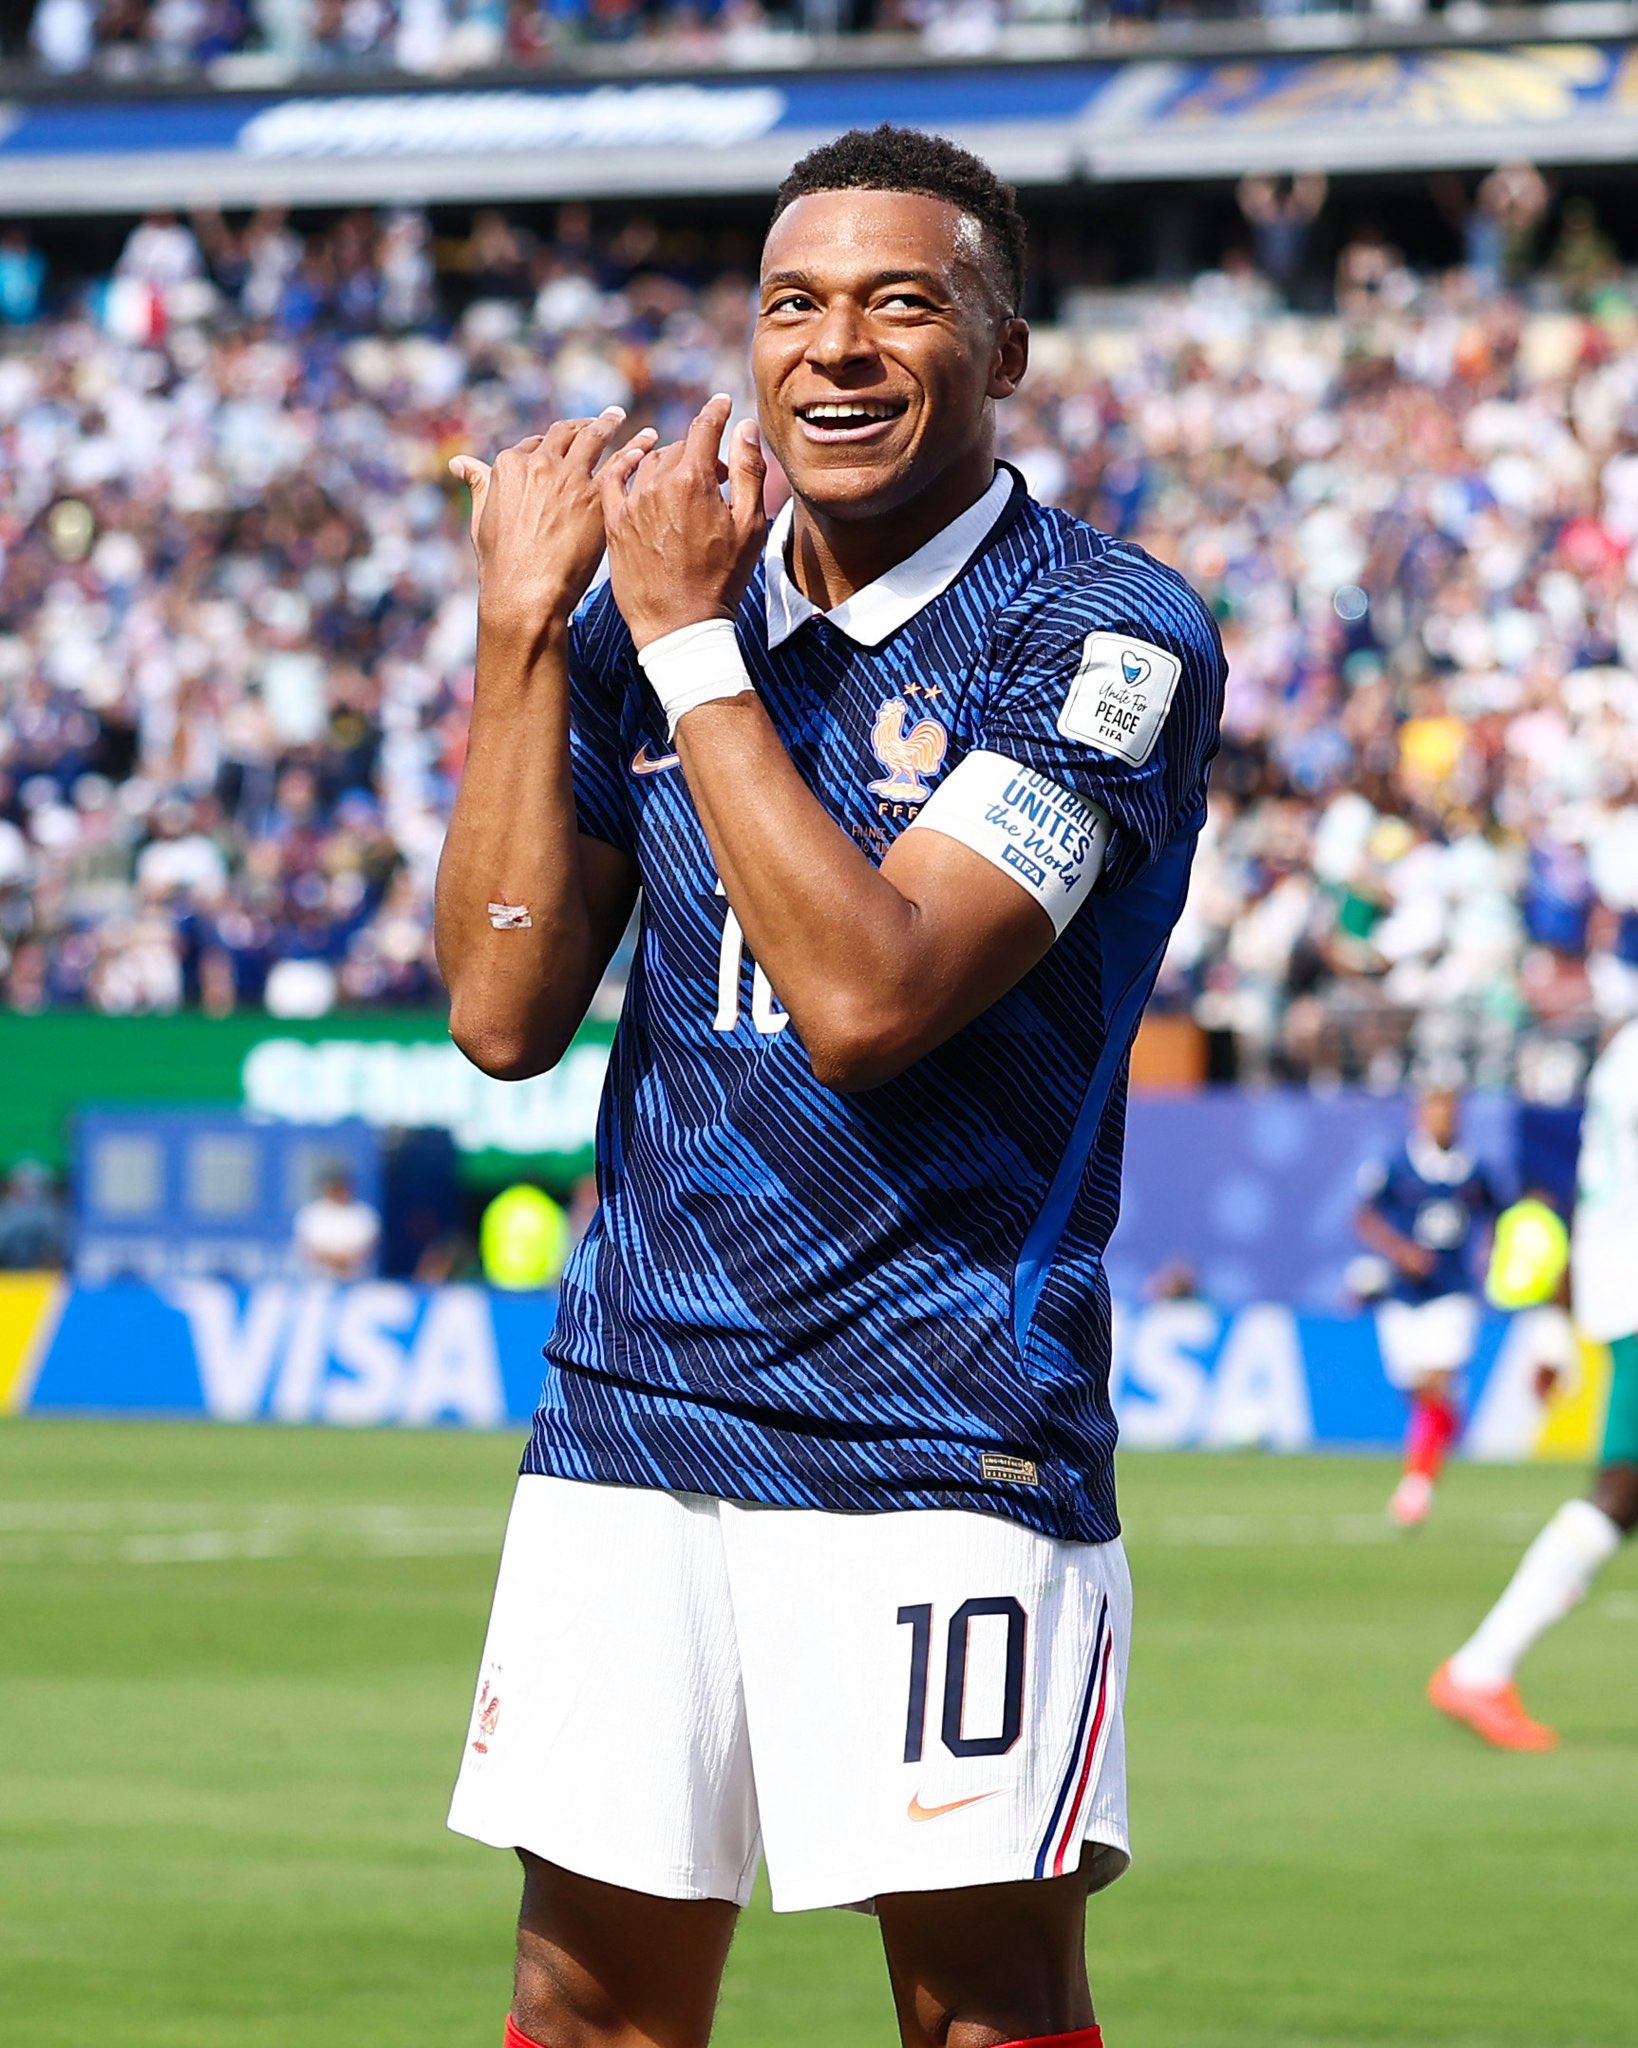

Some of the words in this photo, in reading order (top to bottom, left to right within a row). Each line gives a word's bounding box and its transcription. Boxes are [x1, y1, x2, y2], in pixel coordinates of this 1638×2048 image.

[1095, 700, 1140, 734] PEACE
[1099, 680, 1131, 704] Unite
[1131, 694, 1148, 712] For
[1099, 725, 1122, 742] FIFA
[985, 803, 1022, 836] the
[1023, 828, 1081, 893] World
[1002, 778, 1090, 865] UNITES
[1003, 846, 1046, 886] FIFA
[166, 1278, 506, 1426] VISA
[897, 1596, 1028, 1763] 10
